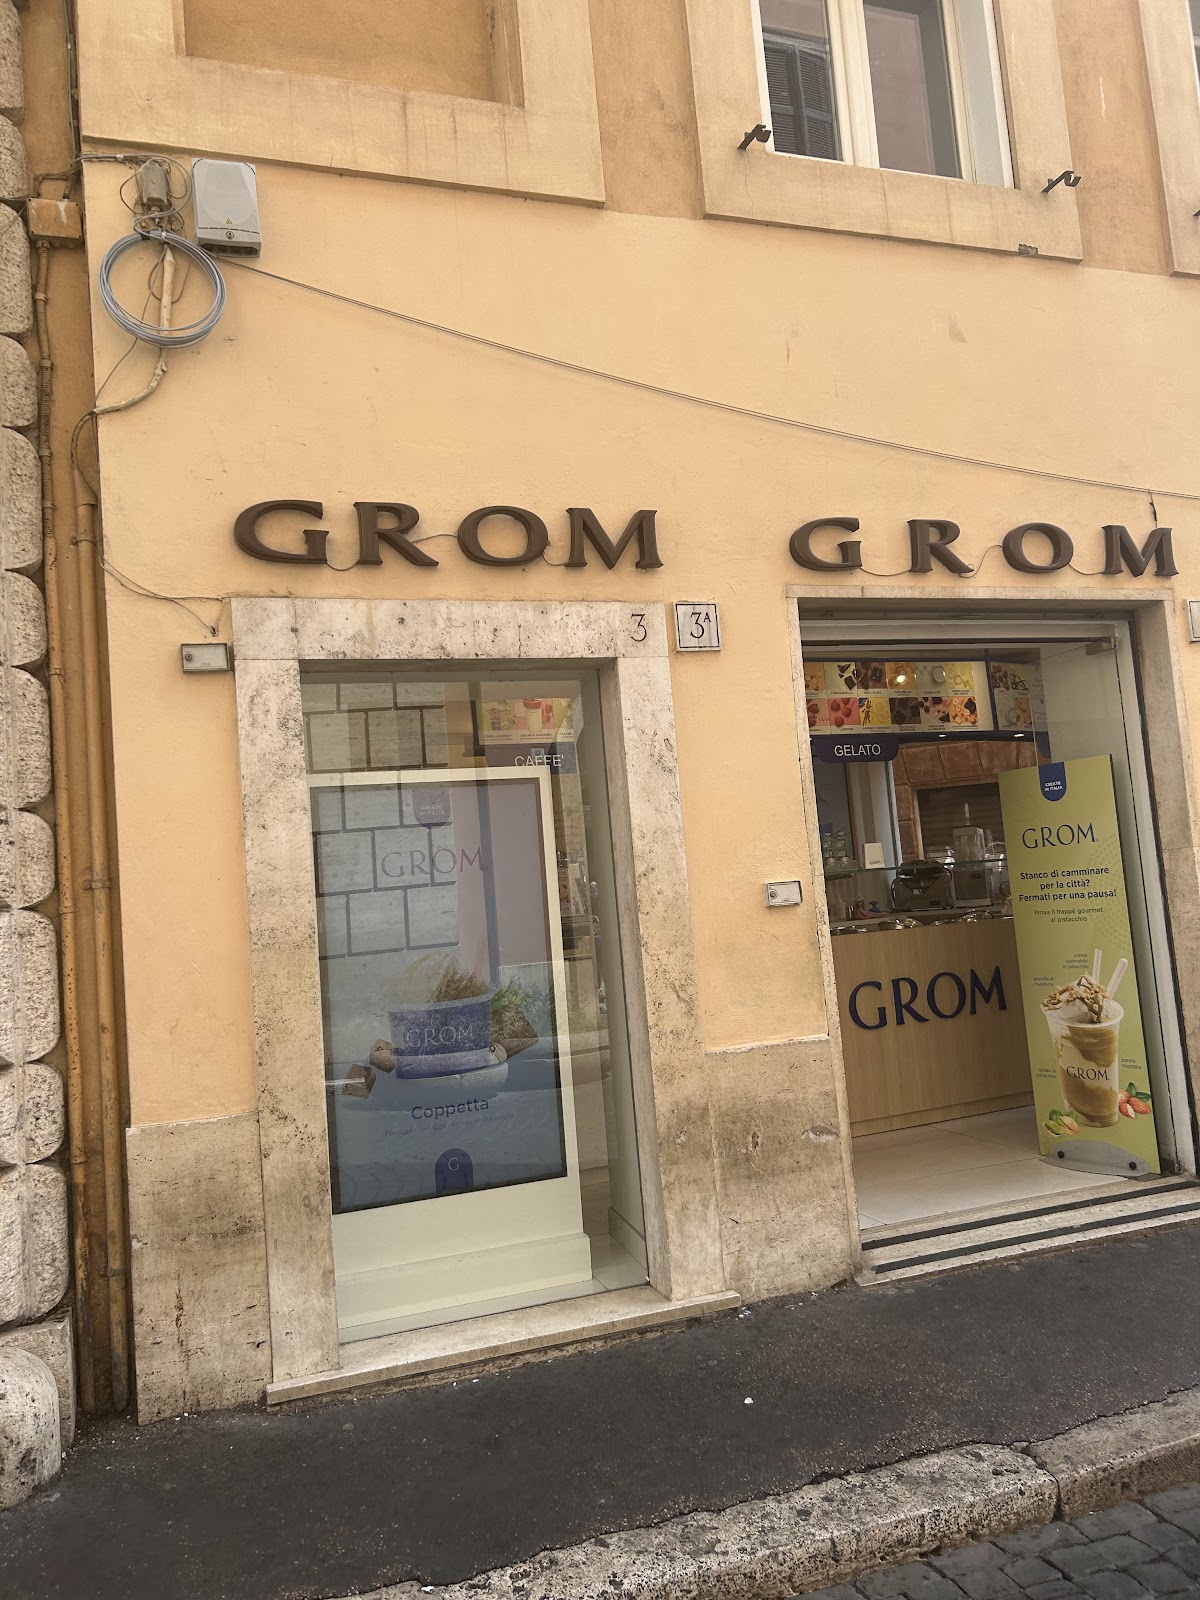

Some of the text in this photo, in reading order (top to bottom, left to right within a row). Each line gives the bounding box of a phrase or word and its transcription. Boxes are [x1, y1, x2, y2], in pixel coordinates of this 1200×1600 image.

[234, 499, 665, 570] GROM
[788, 516, 1180, 578] GROM
[630, 613, 648, 642] 3
[690, 612, 712, 639] 3A
[834, 743, 882, 757] GELATO
[514, 754, 564, 768] CAFFE'
[1021, 822, 1098, 849] GROM
[381, 846, 484, 878] GROM
[1020, 866, 1110, 880] Stanco di camminare
[1040, 879, 1090, 891] per la città?
[1019, 889, 1117, 902] Fermati per una pausa!
[1056, 907, 1076, 916] frappè
[1077, 907, 1104, 915] gourmet
[1057, 915, 1088, 923] pistacchio
[848, 965, 1008, 1030] GROM
[405, 1022, 476, 1048] GROM
[1066, 1065, 1109, 1081] GROM
[411, 1098, 489, 1120] Coppetta
[447, 1157, 460, 1171] G
